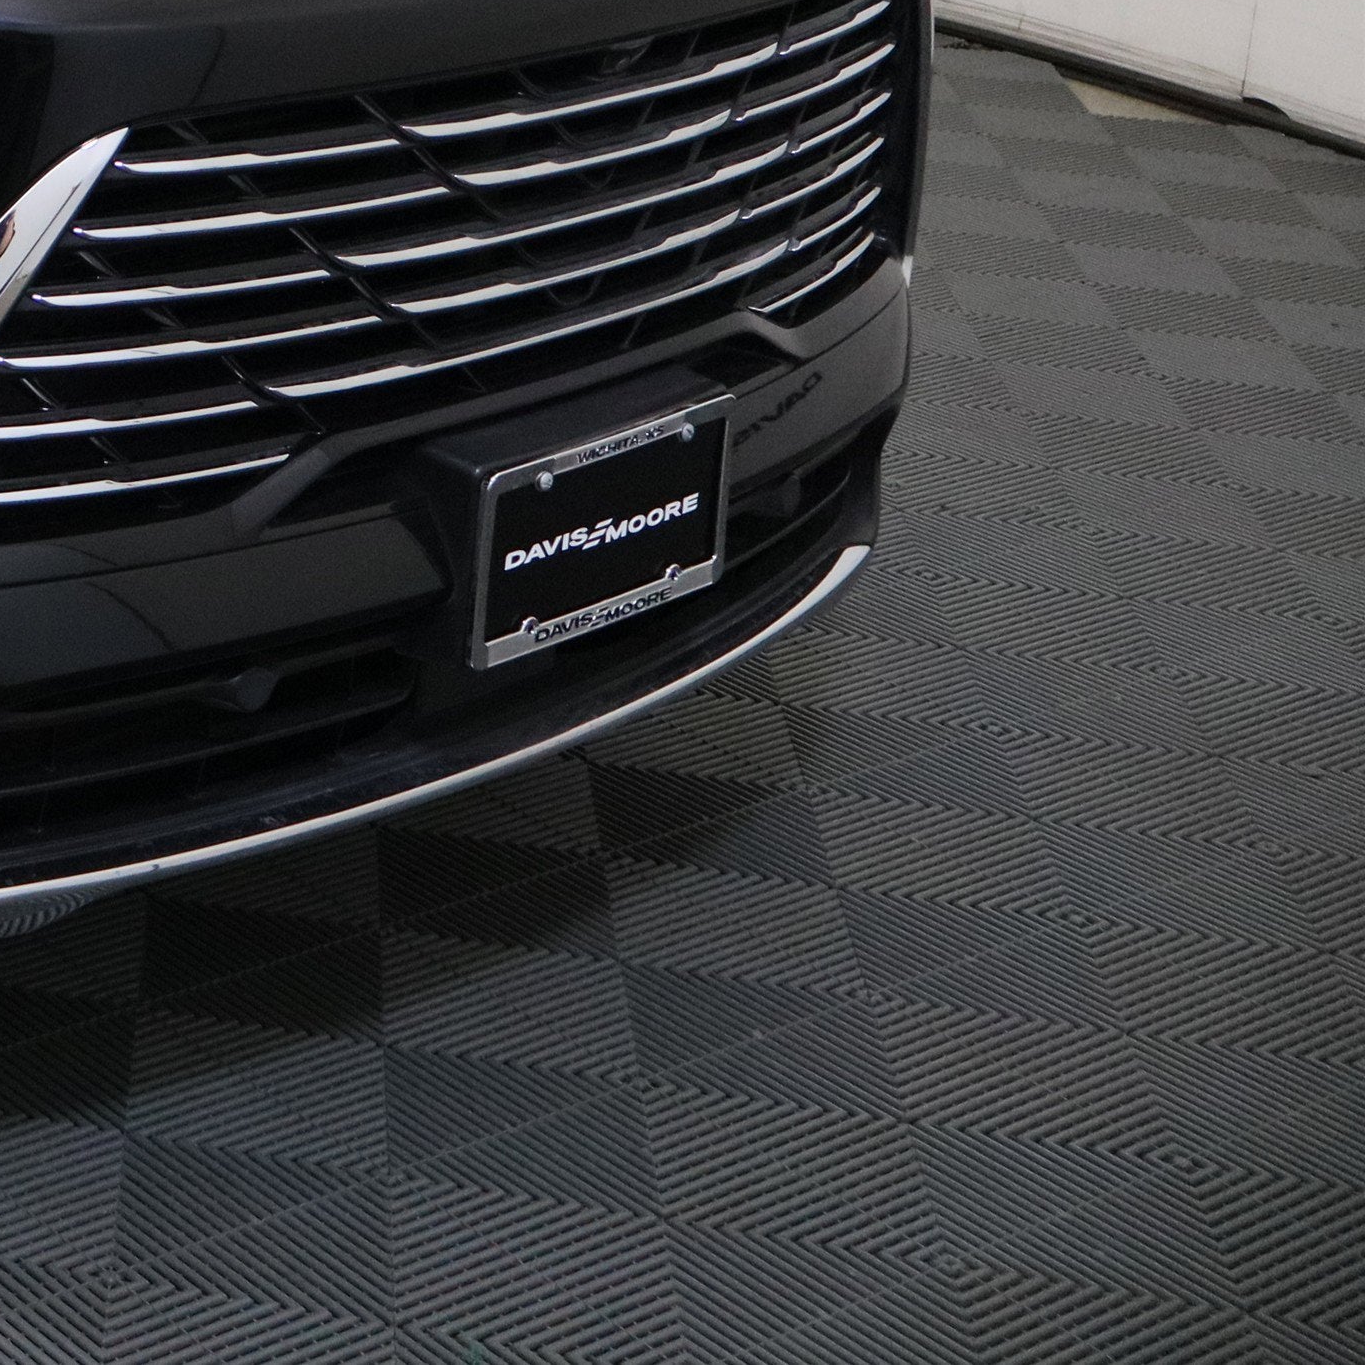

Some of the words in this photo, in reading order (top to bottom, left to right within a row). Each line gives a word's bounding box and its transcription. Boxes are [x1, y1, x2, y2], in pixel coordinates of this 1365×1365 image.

[504, 525, 589, 571] DAVIS
[604, 492, 700, 543] MOORE
[534, 611, 593, 643] DAVIS
[604, 586, 673, 623] MOORE
